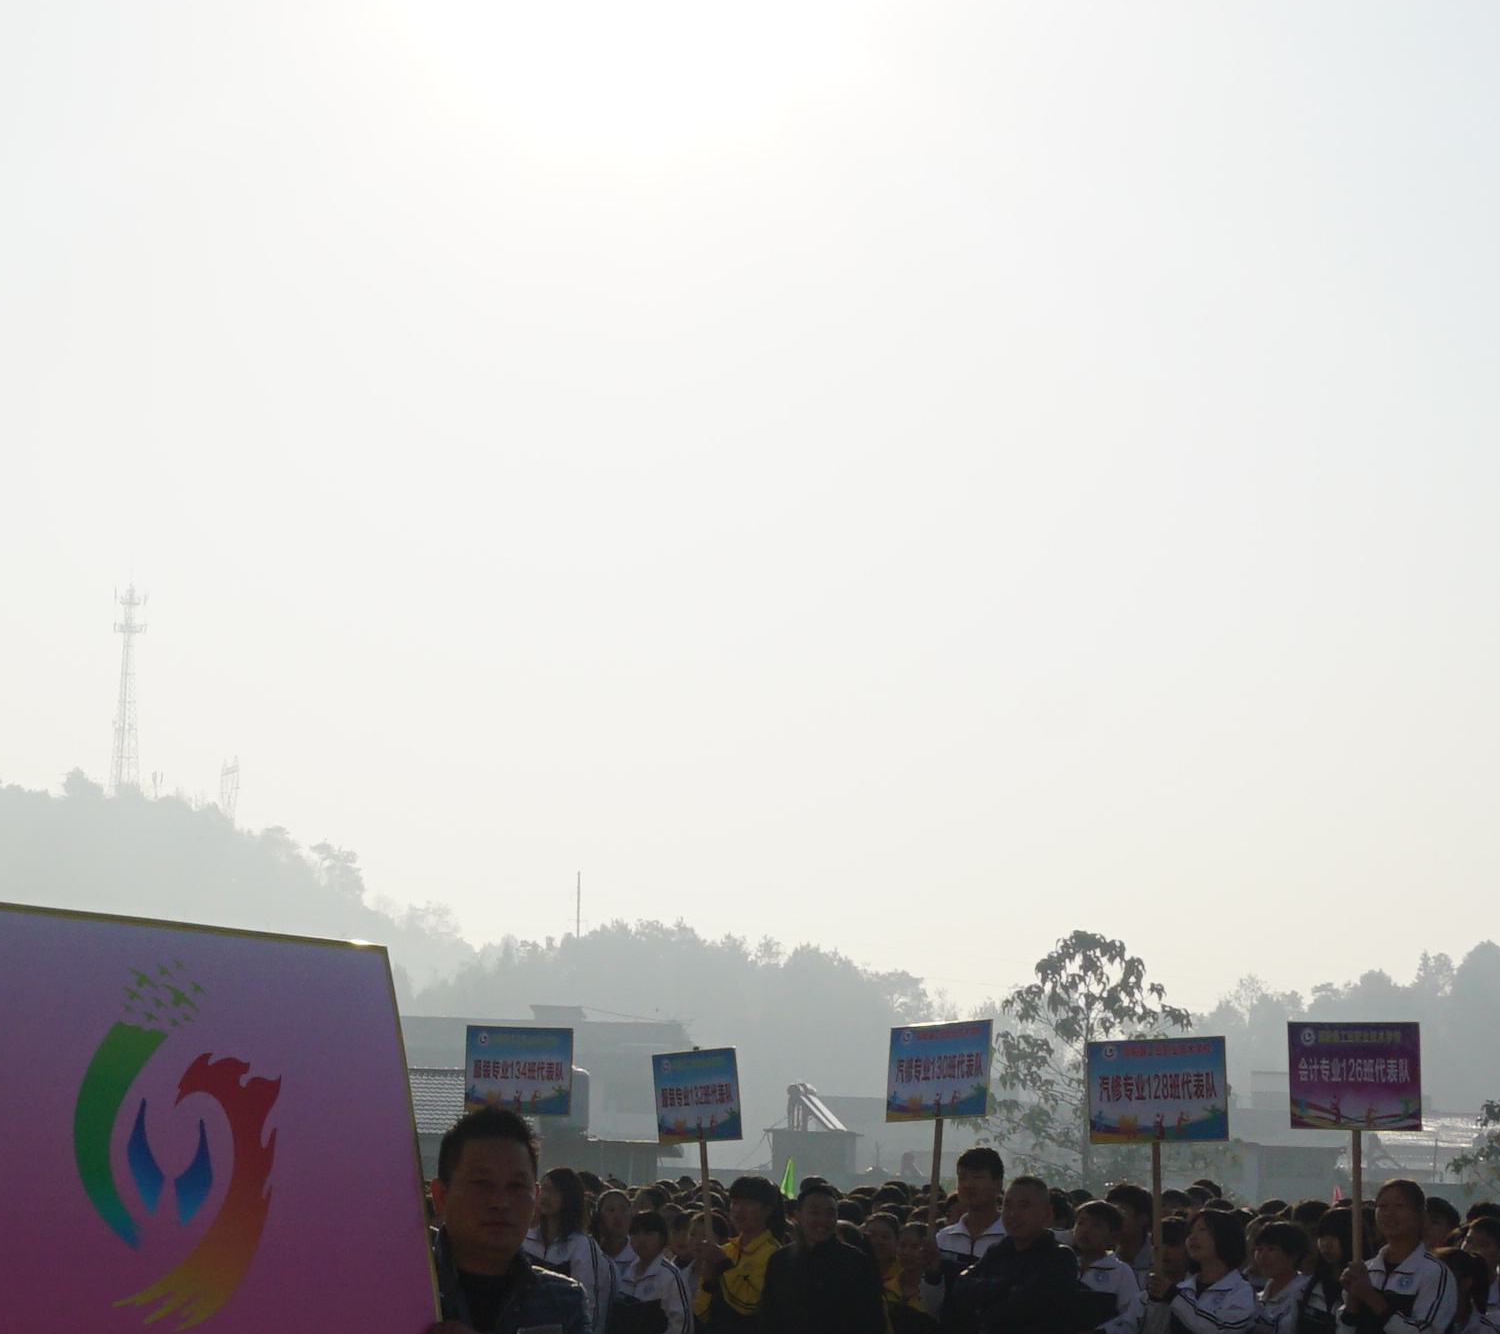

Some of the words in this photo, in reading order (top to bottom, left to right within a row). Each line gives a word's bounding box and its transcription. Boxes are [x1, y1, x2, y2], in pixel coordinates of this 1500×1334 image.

[1297, 1057, 1410, 1083] 会计专业126班代表队
[1098, 1071, 1218, 1102] 汽修专业128班代表队
